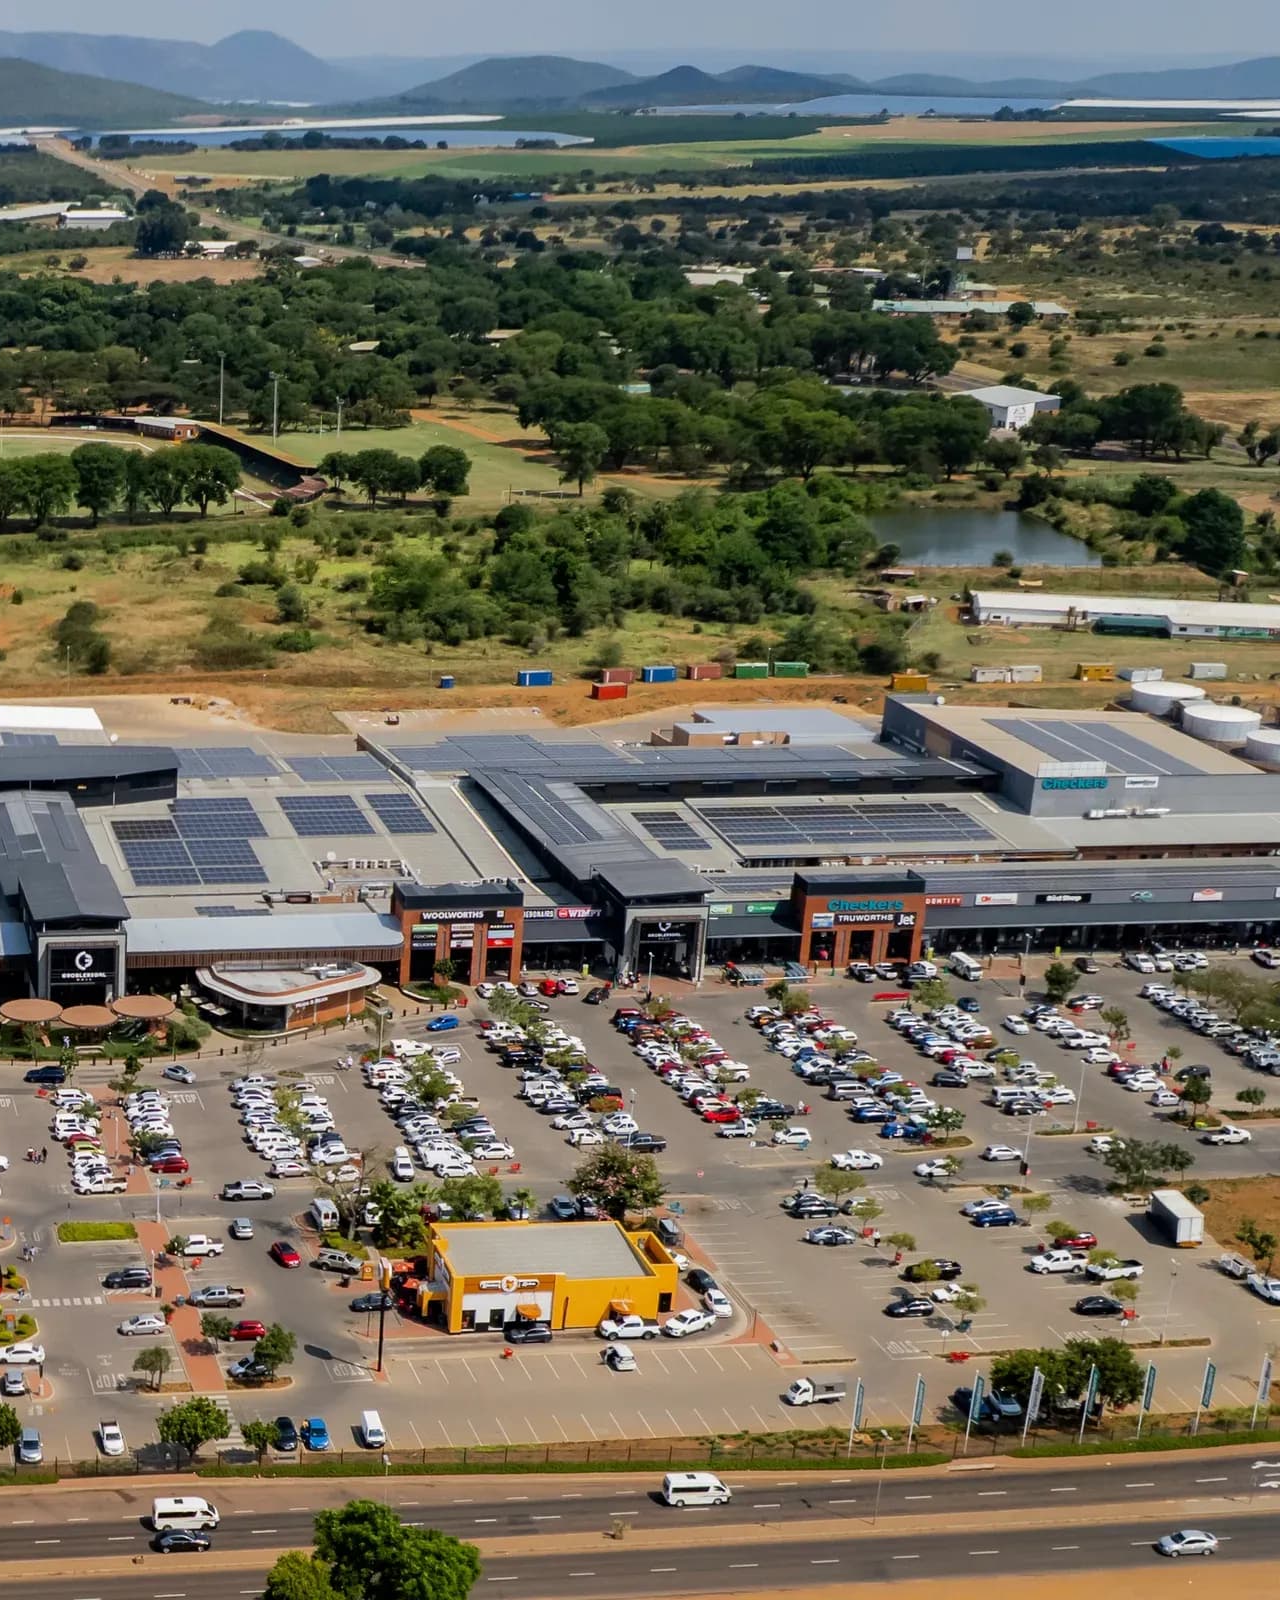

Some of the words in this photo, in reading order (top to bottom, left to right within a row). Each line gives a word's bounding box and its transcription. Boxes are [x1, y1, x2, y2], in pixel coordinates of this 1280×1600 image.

[1041, 776, 1108, 790] Checkers
[827, 898, 904, 911] Checkers
[925, 897, 960, 905] DENTITY
[422, 910, 484, 919] WOOLWORTHS
[838, 914, 894, 922] TRUWORTHS
[897, 914, 915, 925] Jet
[314, 1076, 335, 1085] STOP
[173, 1094, 197, 1104] STOP
